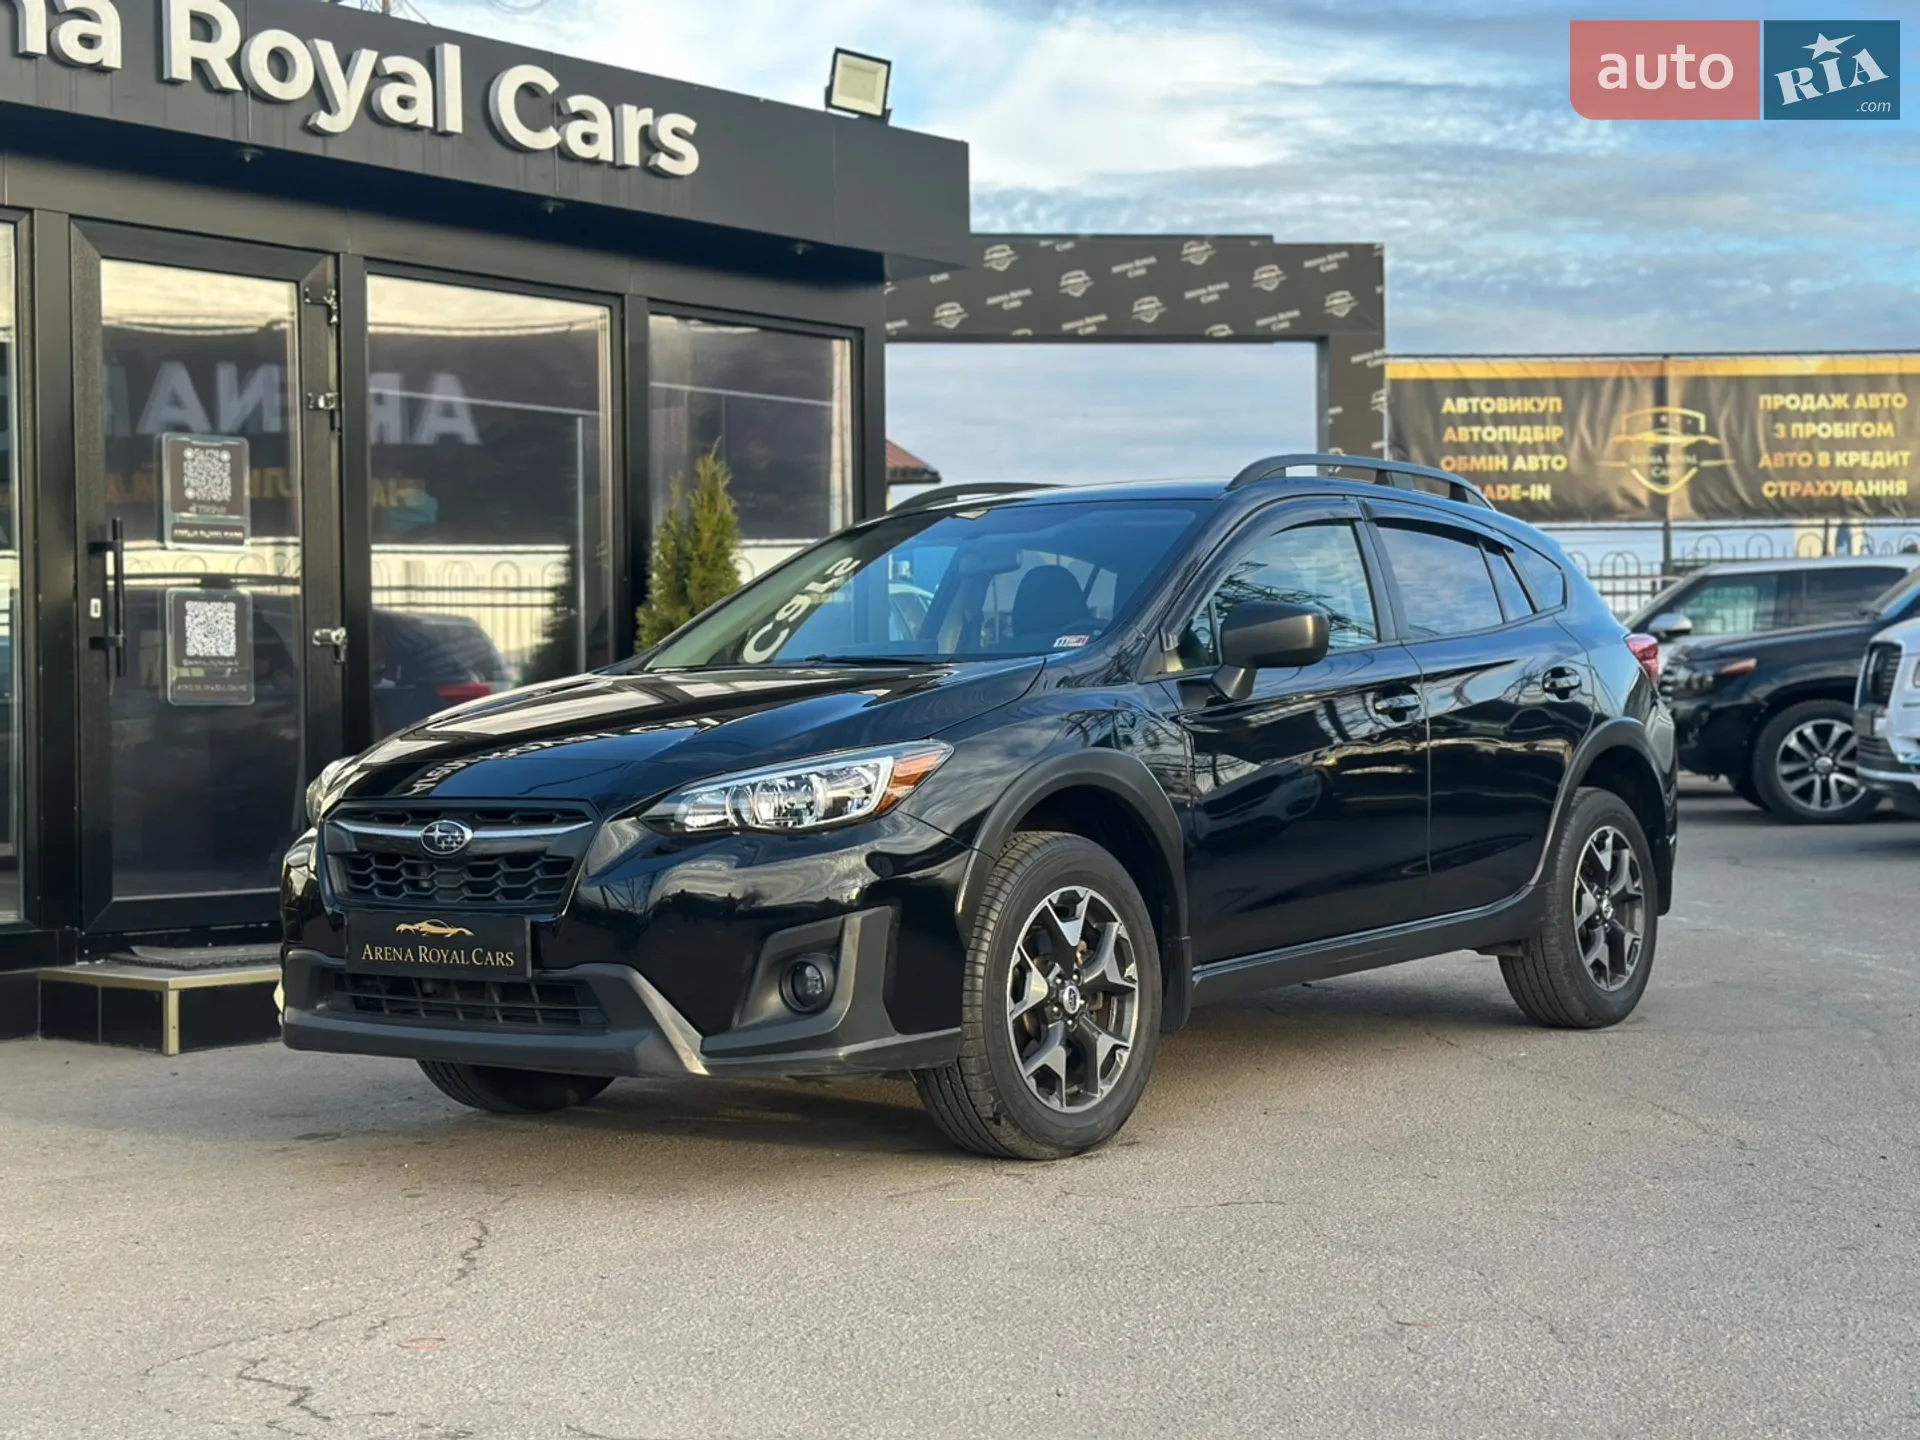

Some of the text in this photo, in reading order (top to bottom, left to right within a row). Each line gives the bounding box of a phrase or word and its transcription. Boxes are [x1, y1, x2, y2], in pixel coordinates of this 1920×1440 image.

[160, 0, 463, 135] Royal
[489, 64, 699, 176] Cars
[1441, 396, 1563, 414] АВТОВИКУП
[1758, 392, 1909, 412] ПРОДАЖ АВТО
[1443, 425, 1565, 444] АВТОПІДБІР
[1791, 421, 1895, 439] ПРОБІГОМ
[1440, 454, 1568, 472] ОБМІН АВТО
[1758, 450, 1912, 470] АВТО В КРЕДИТ
[1476, 483, 1552, 501] ADE-IN
[1761, 479, 1909, 499] СТРАХУВАННЯ
[361, 943, 515, 967] ARENA ROYAL CARS
